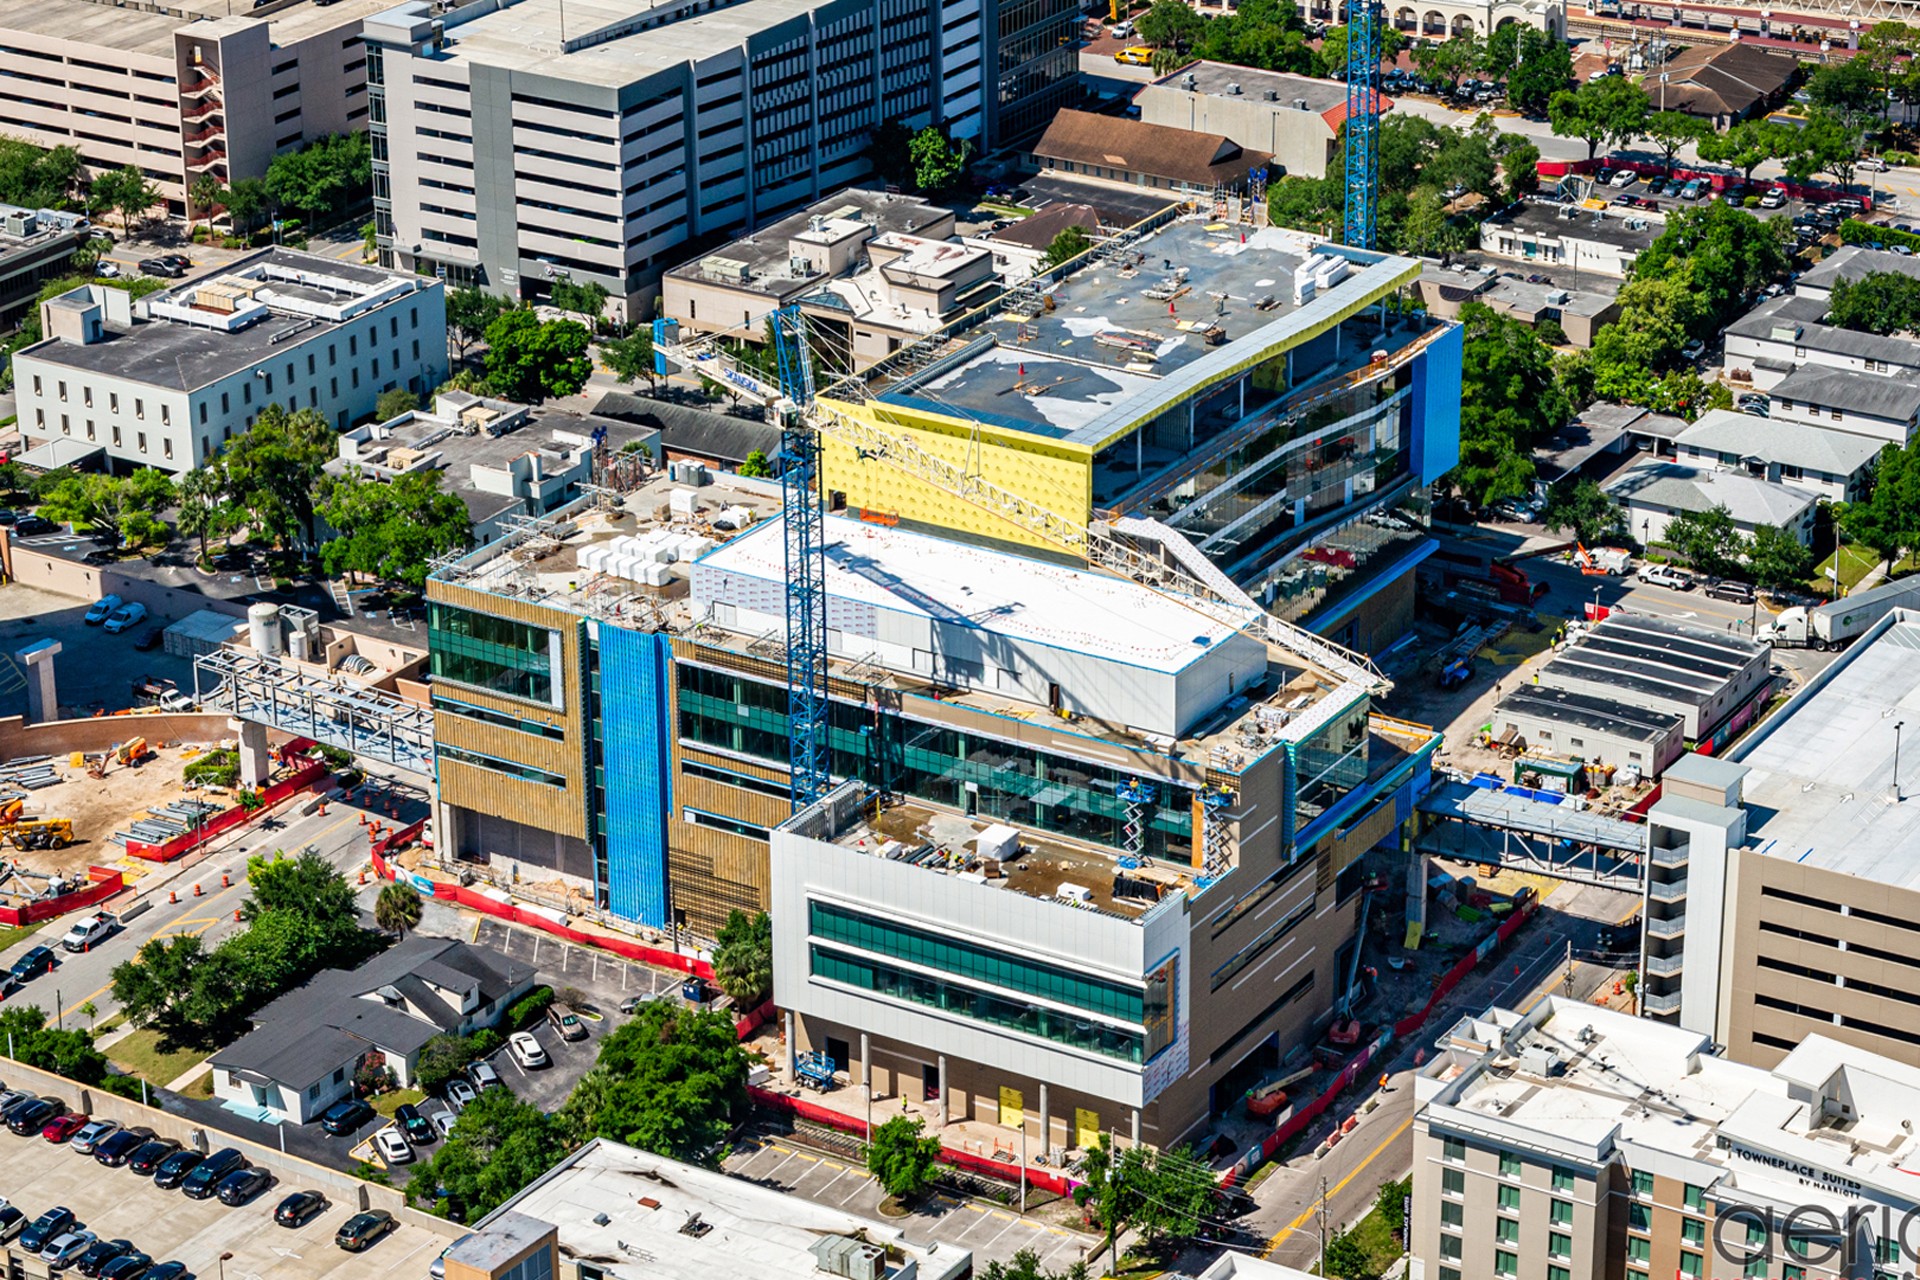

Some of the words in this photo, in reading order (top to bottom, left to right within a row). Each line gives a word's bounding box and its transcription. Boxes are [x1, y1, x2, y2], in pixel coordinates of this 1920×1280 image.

[724, 367, 758, 392] SKANSKA
[1736, 1148, 1815, 1177] TOWNEPLACE
[1822, 1172, 1861, 1189] SUITES
[1799, 1178, 1810, 1187] BY
[1813, 1182, 1860, 1199] MARRIOTT
